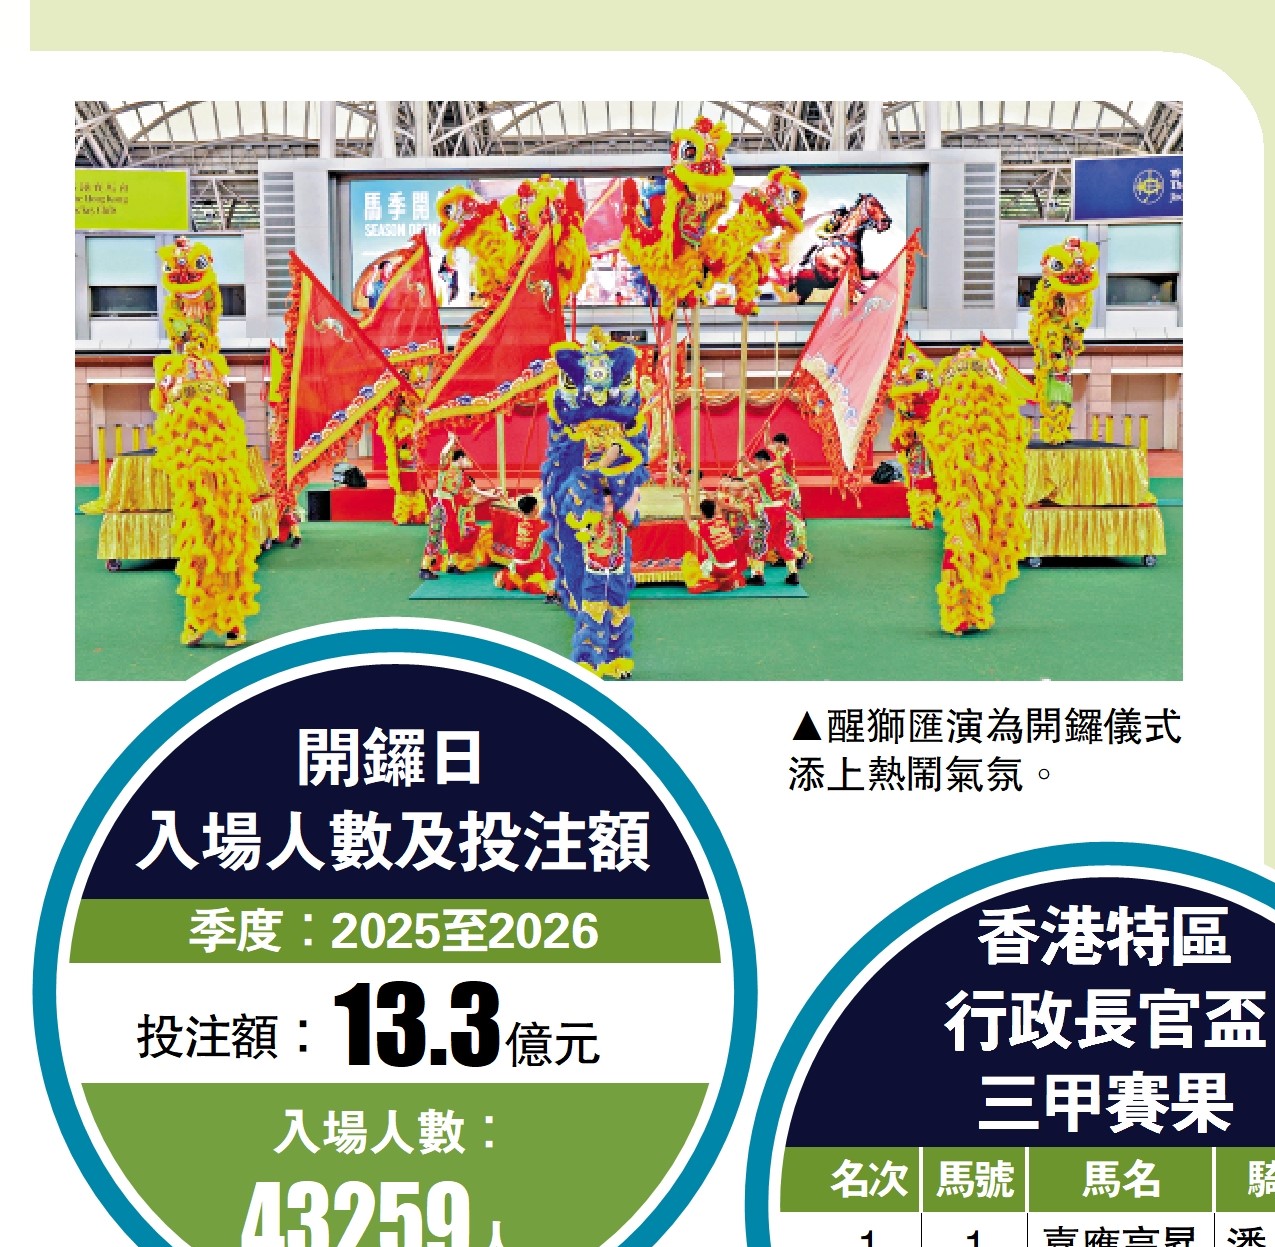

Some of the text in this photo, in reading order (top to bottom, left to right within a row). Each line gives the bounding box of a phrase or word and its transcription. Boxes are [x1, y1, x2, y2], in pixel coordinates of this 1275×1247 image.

[364, 191, 446, 221] 馬季開
[364, 223, 406, 236] SEASON
